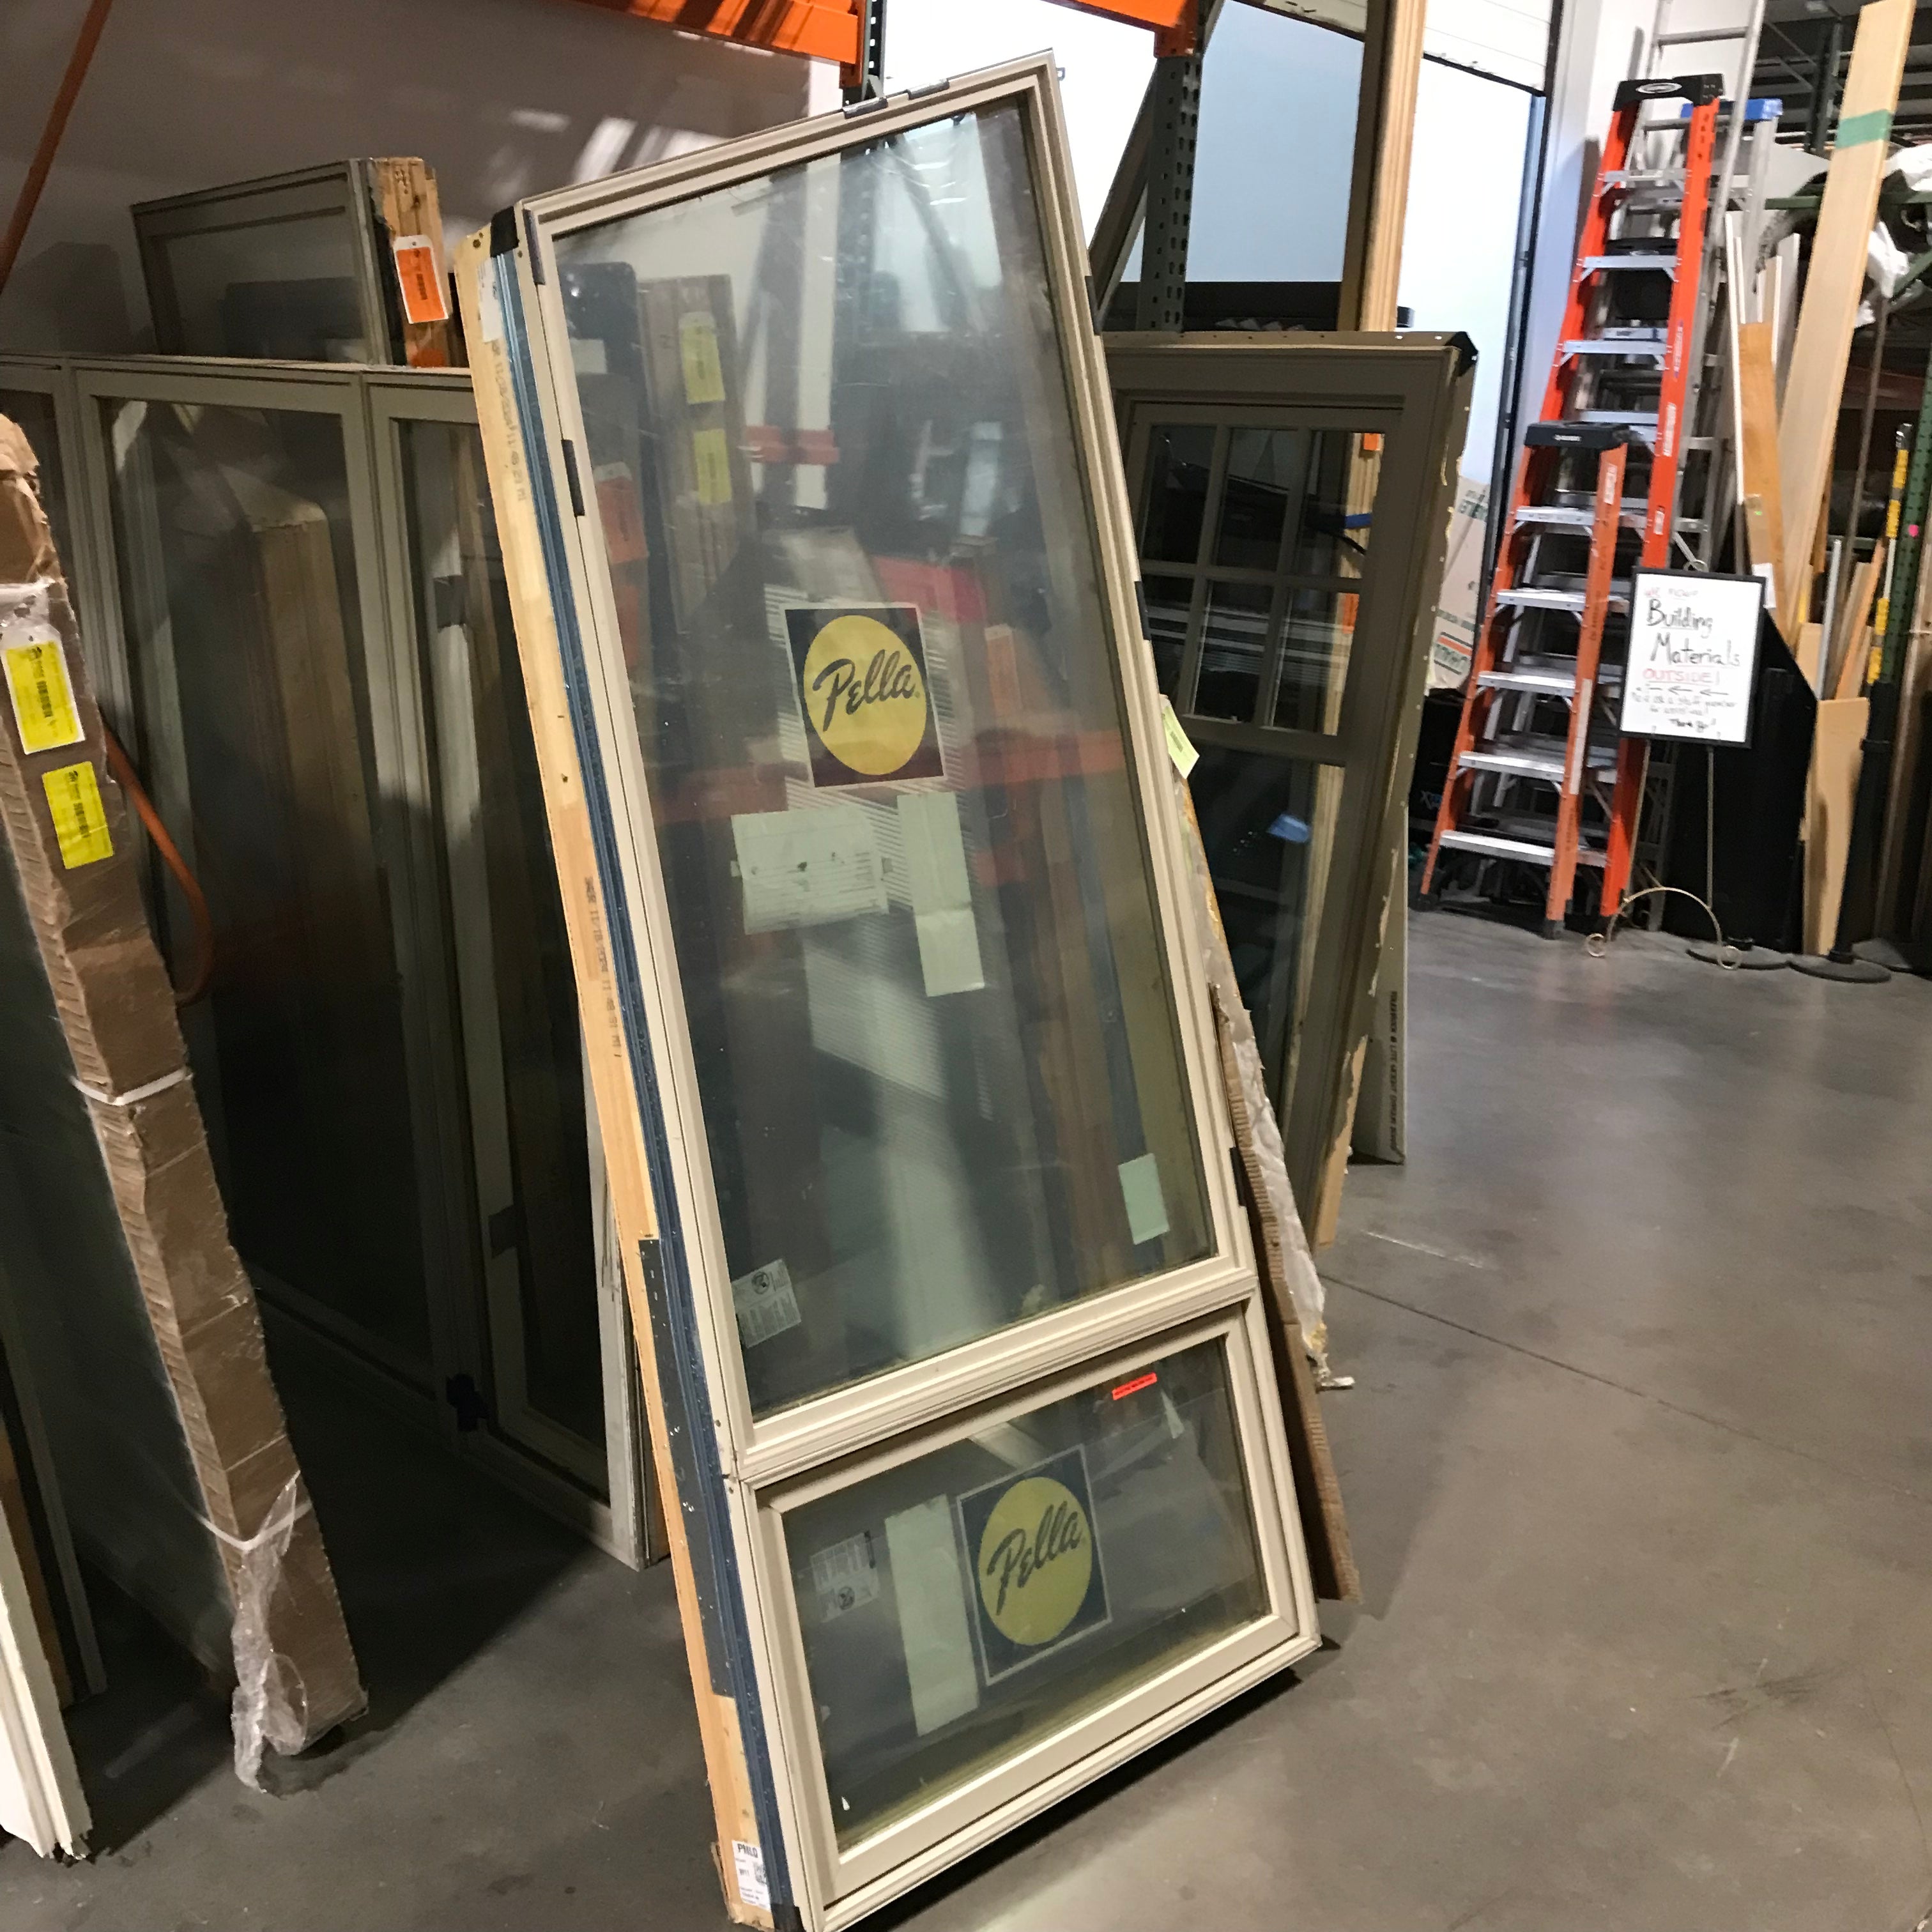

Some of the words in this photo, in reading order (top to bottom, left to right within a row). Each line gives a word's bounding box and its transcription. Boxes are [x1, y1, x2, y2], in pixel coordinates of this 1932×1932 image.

[1646, 598, 1713, 639] Building
[1650, 631, 1741, 667] Materials
[812, 648, 916, 732] Pella
[986, 1501, 1083, 1616] Pella
